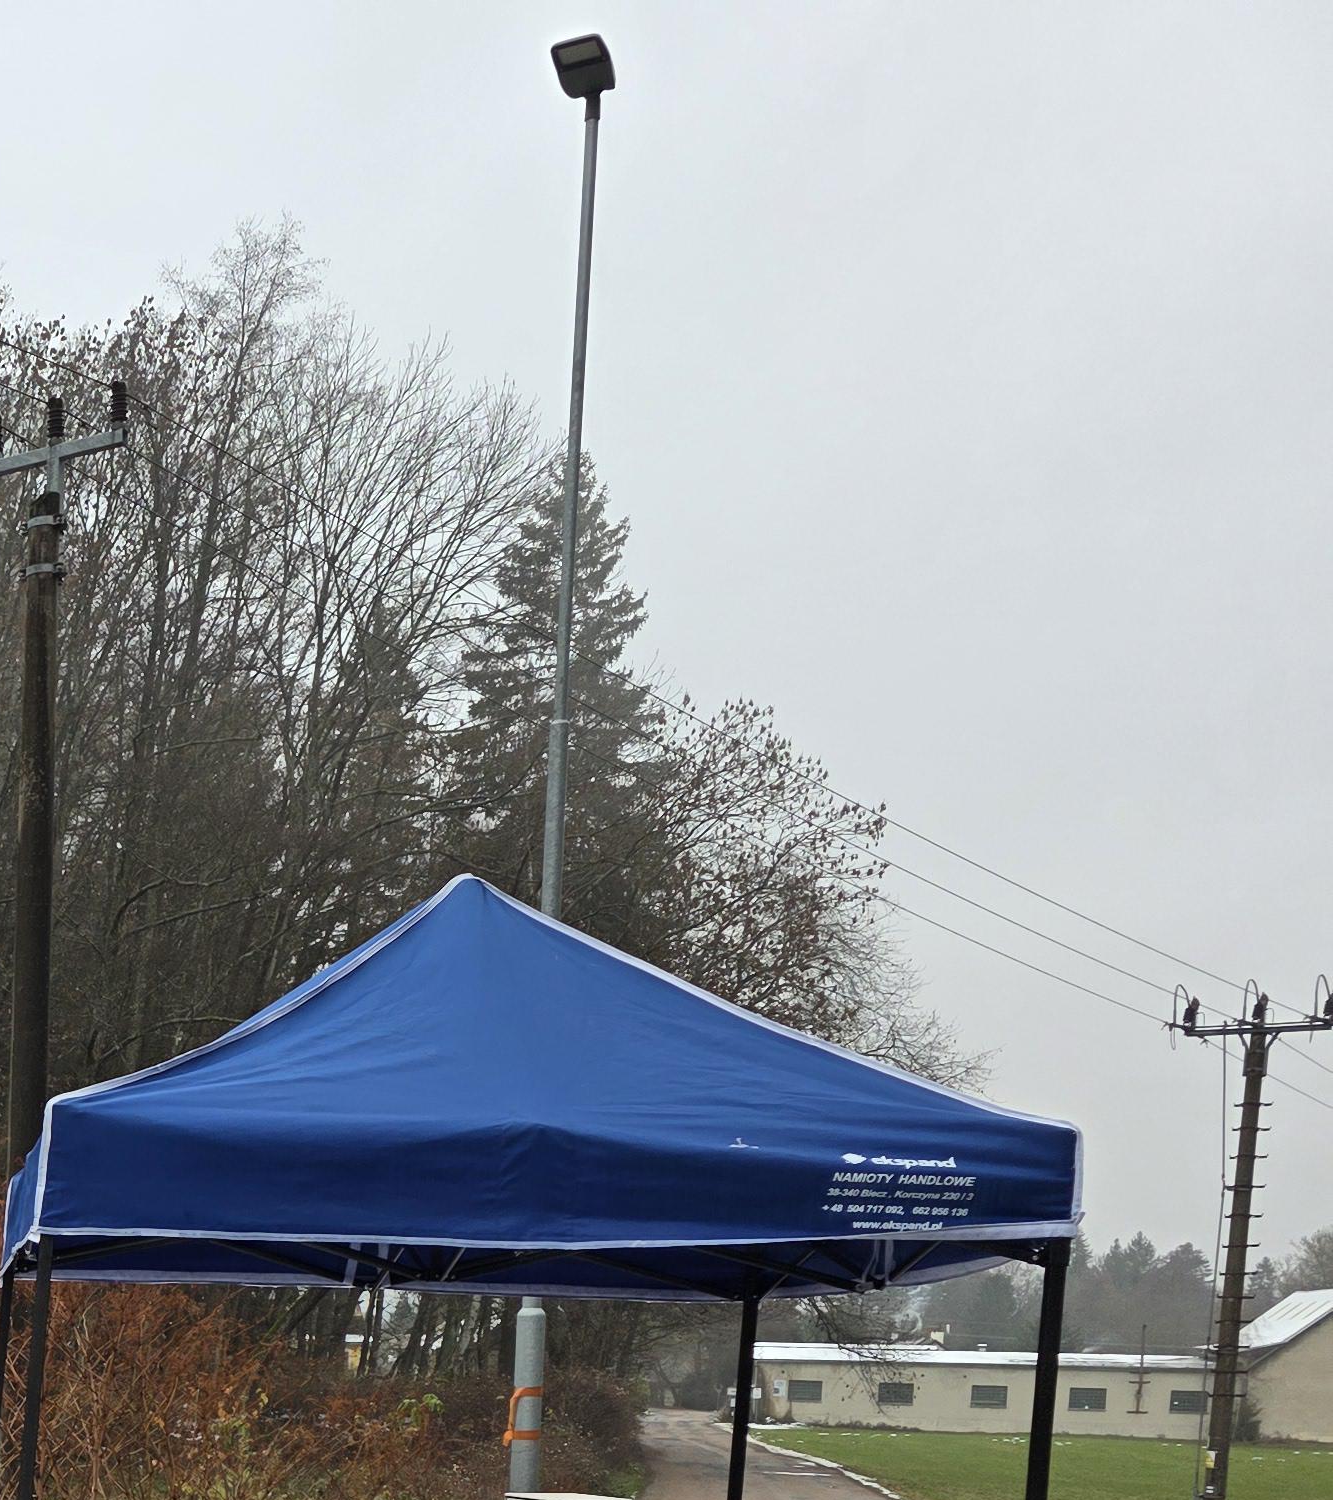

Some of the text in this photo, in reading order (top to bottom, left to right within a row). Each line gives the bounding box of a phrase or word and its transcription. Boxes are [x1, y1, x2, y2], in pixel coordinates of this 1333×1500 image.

[832, 1172, 976, 1187] NAMIOTY HANDLOWE
[847, 1204, 865, 1213] 504
[866, 1205, 884, 1214] 717
